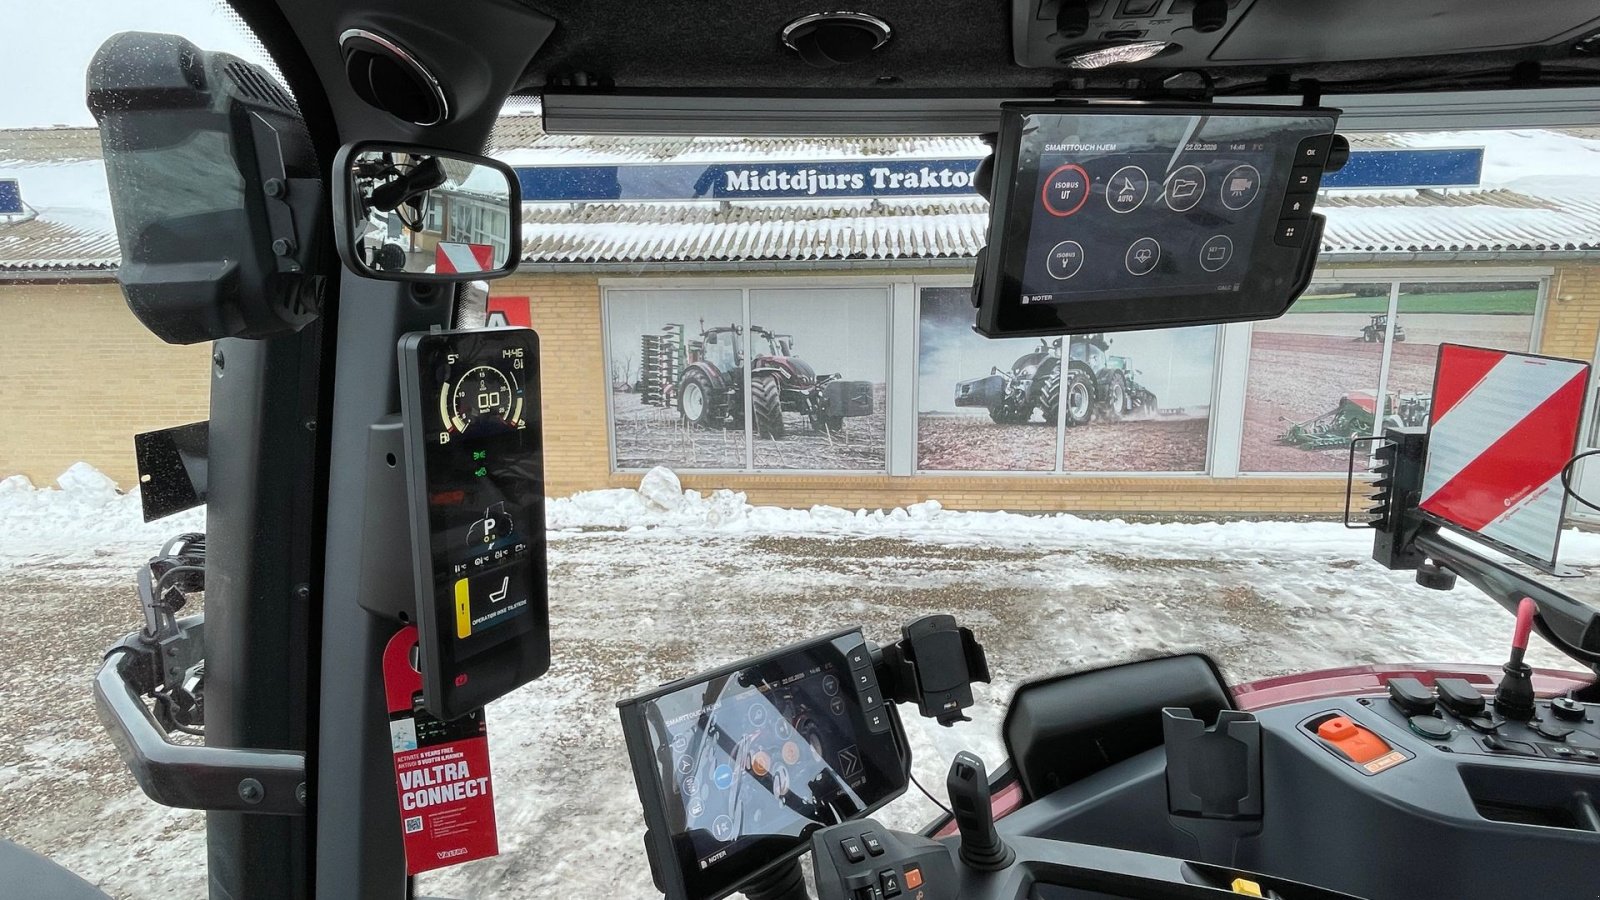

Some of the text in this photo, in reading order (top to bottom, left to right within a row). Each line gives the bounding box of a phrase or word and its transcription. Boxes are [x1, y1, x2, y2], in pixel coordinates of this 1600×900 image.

[725, 170, 864, 194] Midtdjurs
[1061, 190, 1070, 200] UT
[484, 518, 496, 536] P
[398, 754, 420, 762] ACTIVATE
[400, 760, 470, 790] VALTRA
[402, 777, 488, 810] CONNECT
[436, 847, 468, 860] VALTRA
[708, 850, 726, 863] NOTER
